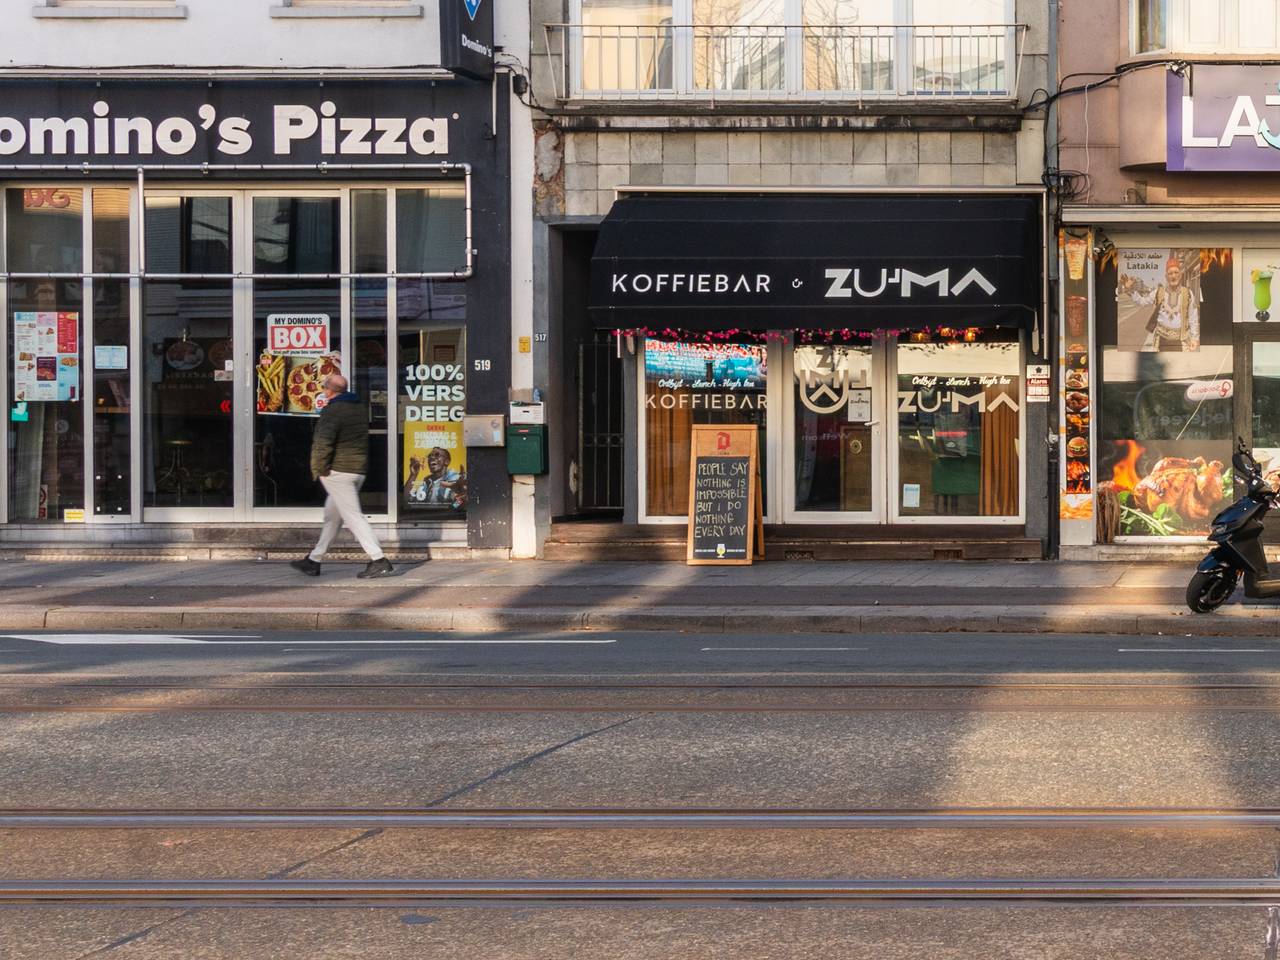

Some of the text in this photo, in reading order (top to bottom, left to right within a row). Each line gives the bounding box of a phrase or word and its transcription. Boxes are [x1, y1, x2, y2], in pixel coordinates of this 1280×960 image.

[461, 34, 492, 57] Domino's
[273, 100, 449, 155] Pizza
[1126, 262, 1158, 270] Latakia
[611, 274, 771, 293] KOFFIEBAR
[287, 317, 323, 325] DOMINO'S
[273, 327, 324, 348] BOX
[474, 359, 491, 371] 519
[405, 364, 464, 381] 100%
[405, 385, 465, 401] VERS
[645, 394, 768, 409] KOFFIEBAR
[405, 405, 464, 422] DEEG
[698, 462, 748, 476] PEOPLE SAY
[697, 478, 746, 488] NOTHING IS
[696, 488, 747, 500] IMPOSSIBLE
[697, 501, 713, 512] BUT
[727, 501, 742, 511] DO
[695, 514, 735, 525] NOTHING
[695, 524, 746, 538] EVERY DAY
